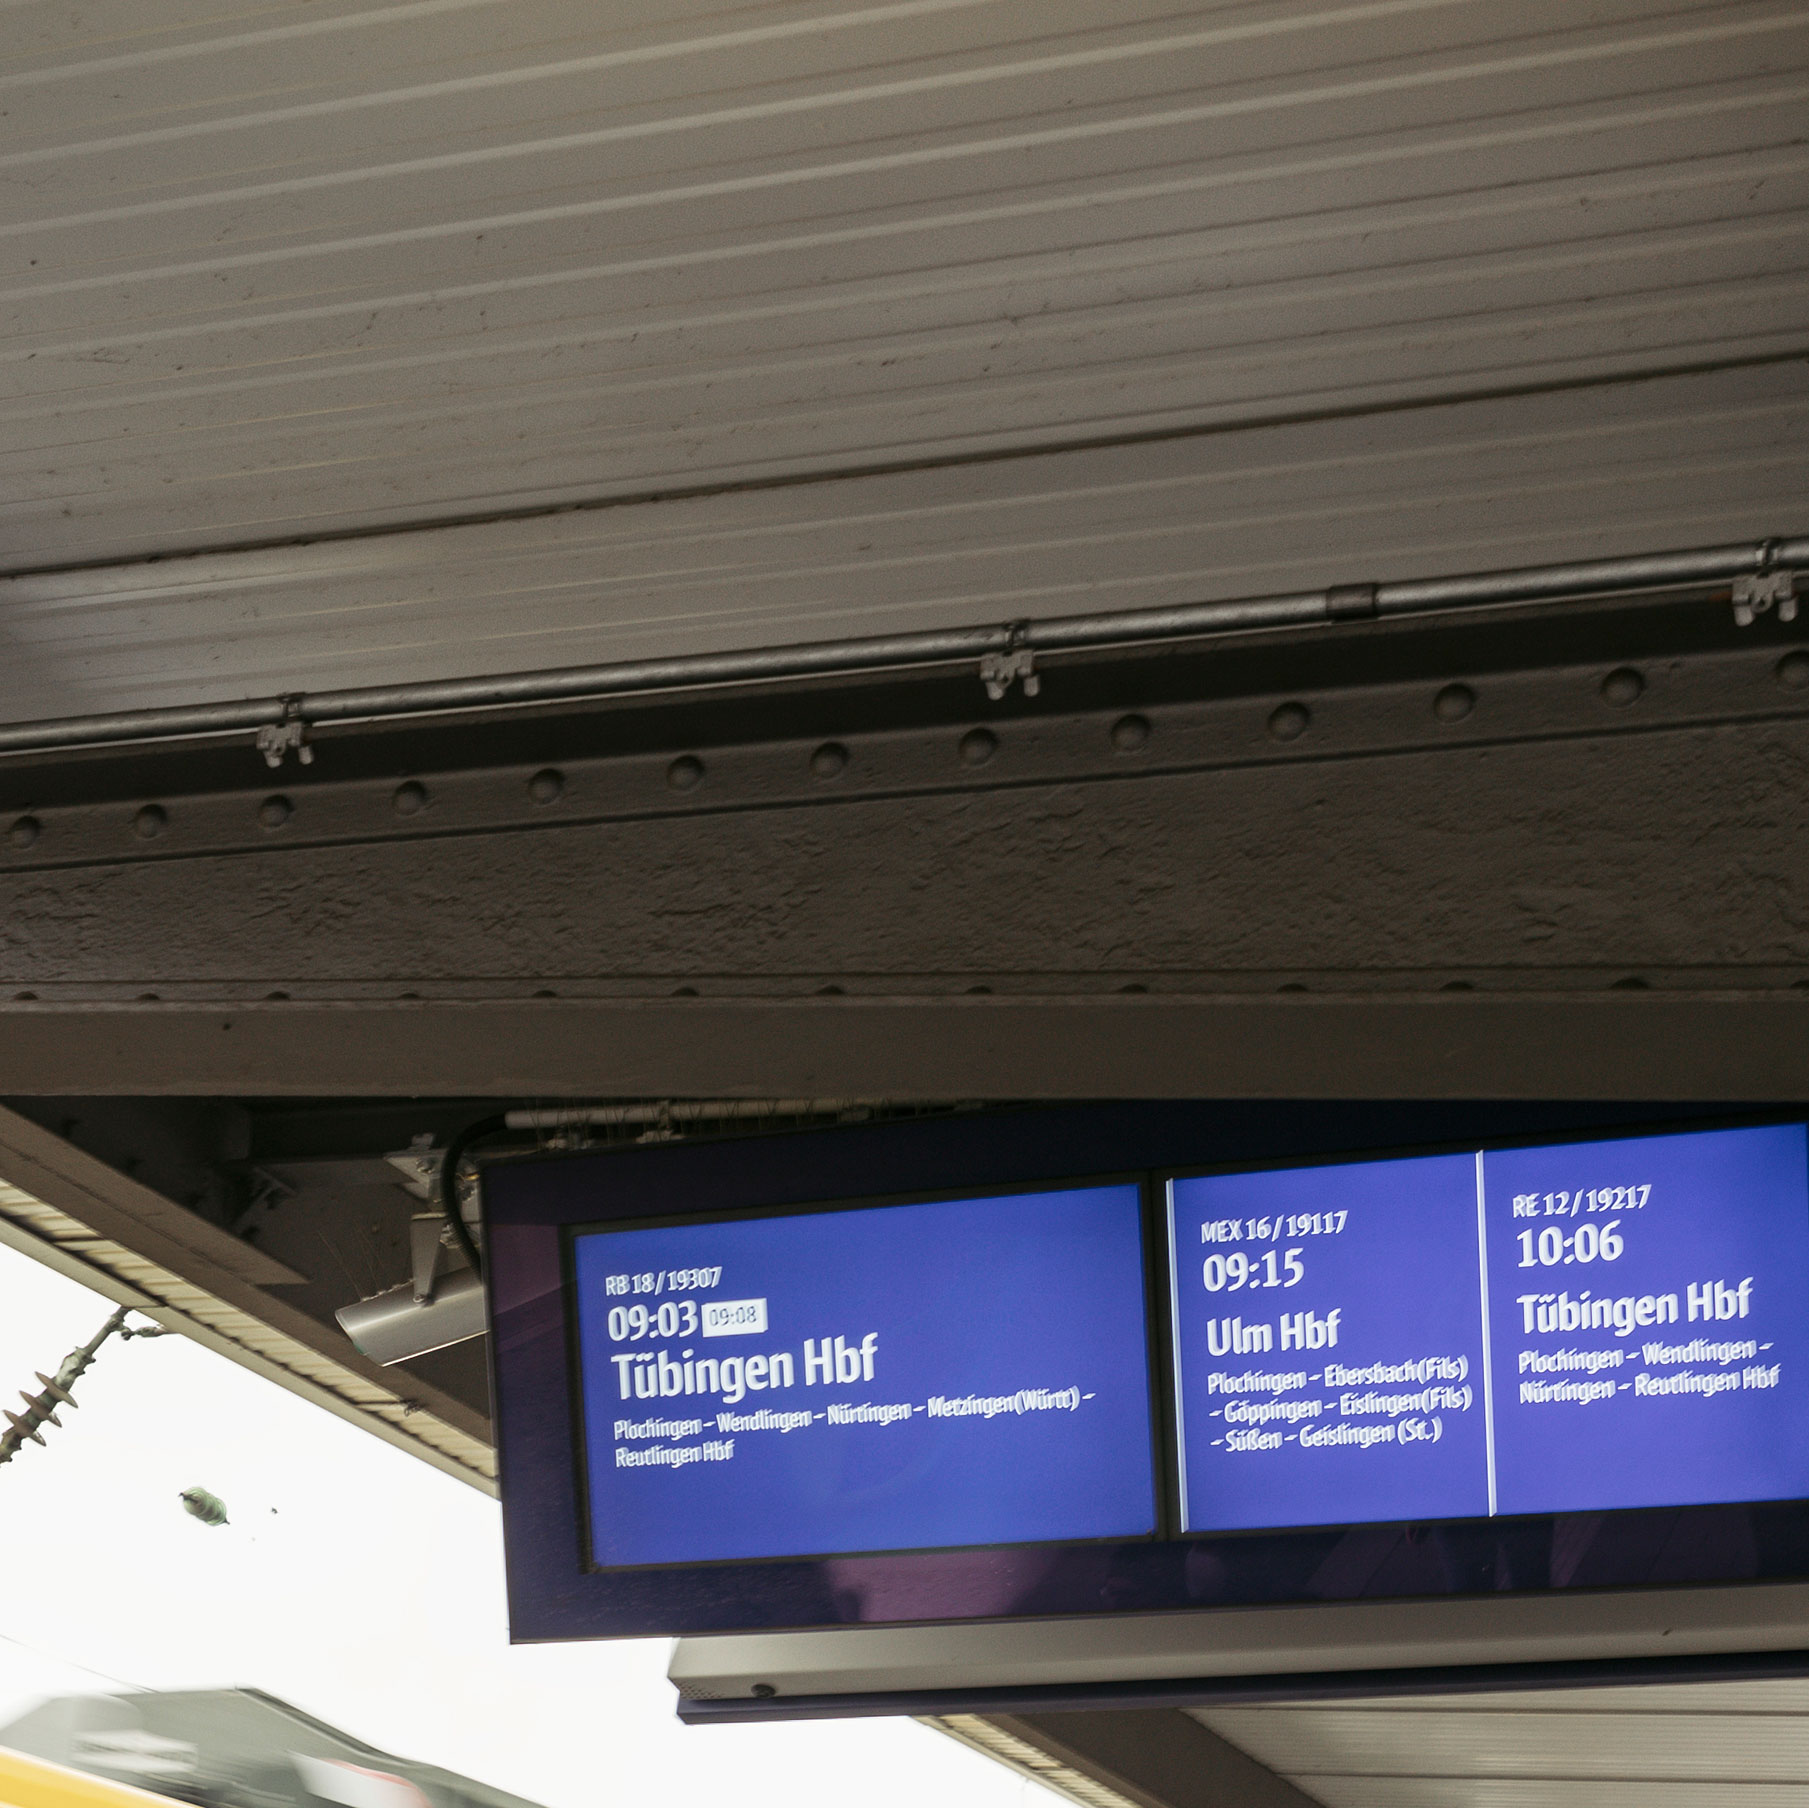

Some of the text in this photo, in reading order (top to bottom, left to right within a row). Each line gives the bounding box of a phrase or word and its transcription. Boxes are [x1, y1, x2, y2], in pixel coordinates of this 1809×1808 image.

[1513, 1184, 1652, 1219] RE 12 / 19217
[1201, 1210, 1349, 1244] MEX 16 / 19117
[1516, 1219, 1624, 1268] 10:06
[605, 1266, 723, 1297] RB 18 / 19307
[1202, 1247, 1305, 1293] 09:15
[607, 1300, 758, 1342] 09:03 09:08
[1516, 1276, 1754, 1337] Tübingen Hbf
[1206, 1307, 1342, 1357] Ulm Hbf
[610, 1331, 879, 1405] Tübingen Hbf
[1518, 1347, 1624, 1375] Plochingen
[1641, 1337, 1758, 1366] Wendlingen
[1207, 1370, 1307, 1396] Plochingen
[1519, 1378, 1616, 1405] Nürtingen
[1634, 1369, 1741, 1398] Reutlingen
[1742, 1363, 1782, 1390] Hbf
[613, 1417, 702, 1441] Plochingen
[715, 1409, 813, 1434] Wendlingen
[826, 1402, 913, 1427] Nürtingen
[1224, 1399, 1323, 1426] Göppingen
[1225, 1428, 1284, 1452] Süßen
[1299, 1422, 1396, 1448] Geislingen
[1397, 1415, 1443, 1445] (St.)
[615, 1438, 735, 1468] Reutlingen Hbf
